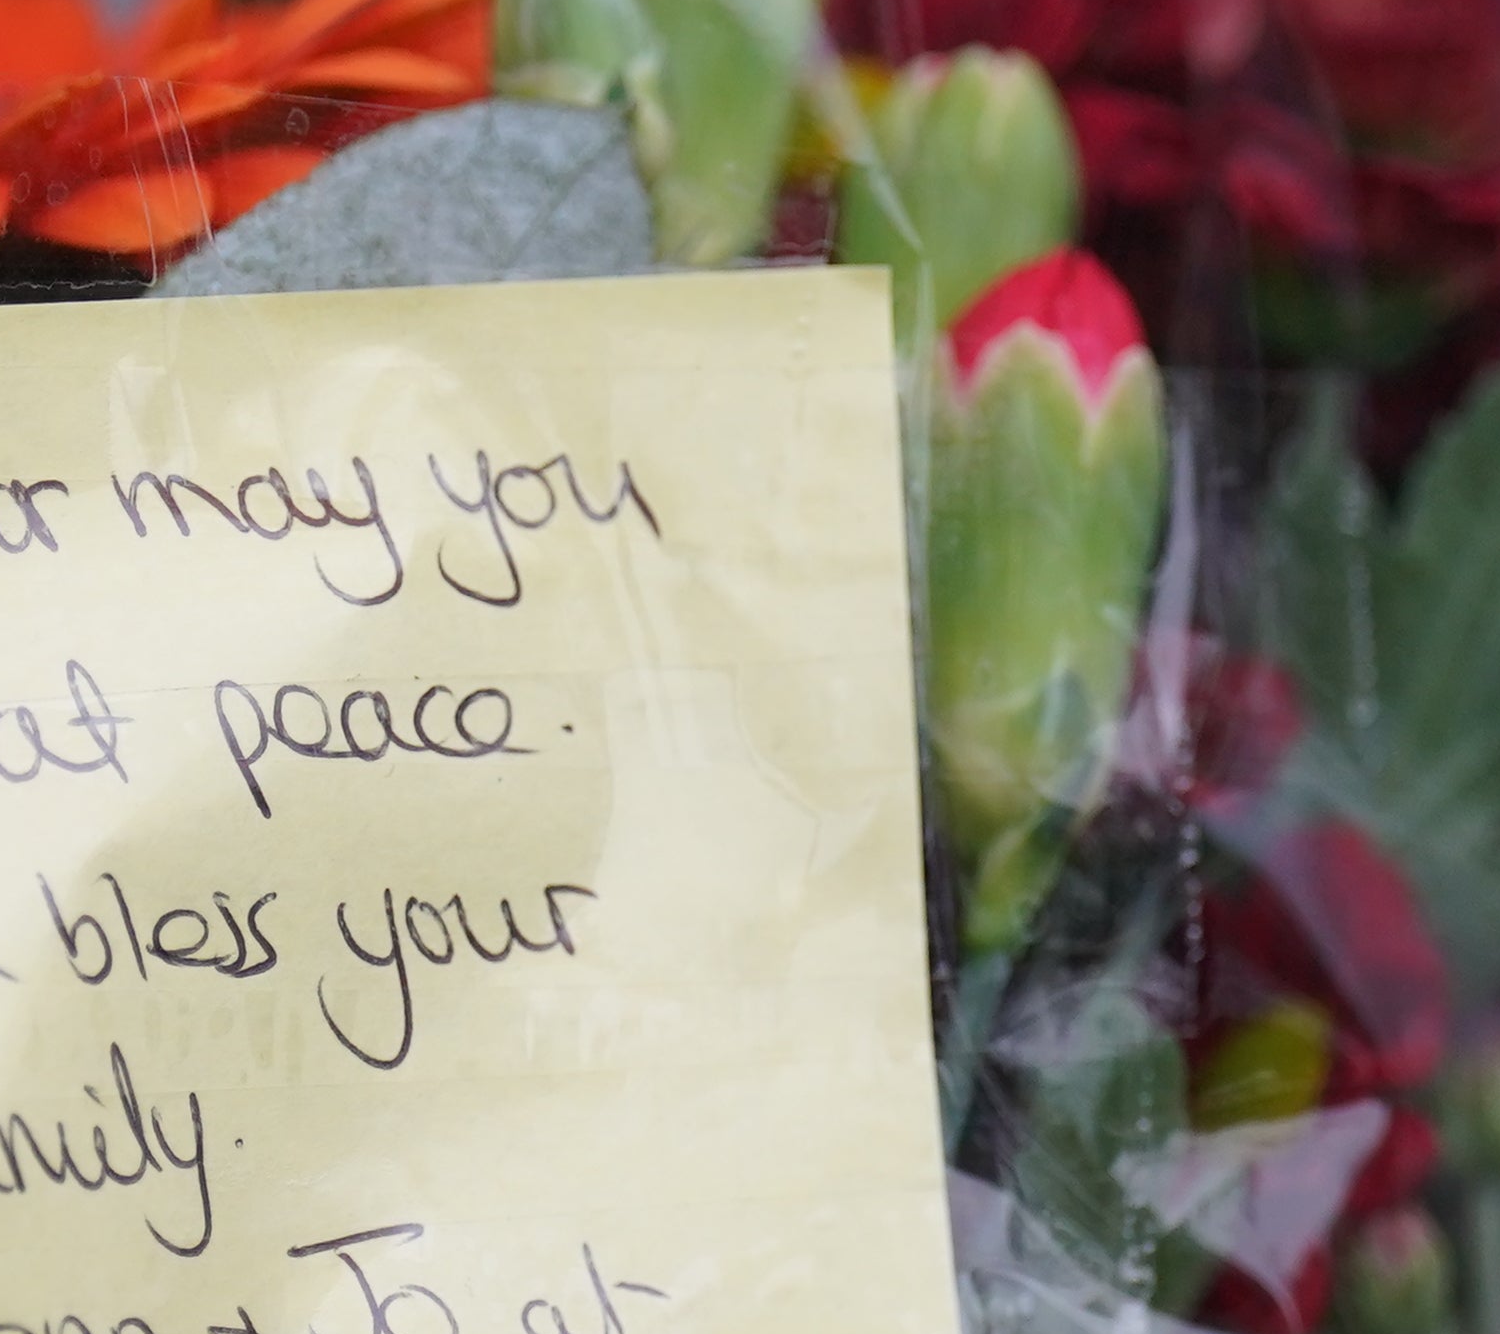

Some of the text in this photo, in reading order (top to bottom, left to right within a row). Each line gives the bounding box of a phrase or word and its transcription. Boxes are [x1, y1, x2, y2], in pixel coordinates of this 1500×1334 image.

[113, 454, 405, 606] may
[428, 445, 660, 606] you
[215, 675, 573, 817] peace.
[38, 872, 278, 984] bless
[319, 886, 598, 1069] your
